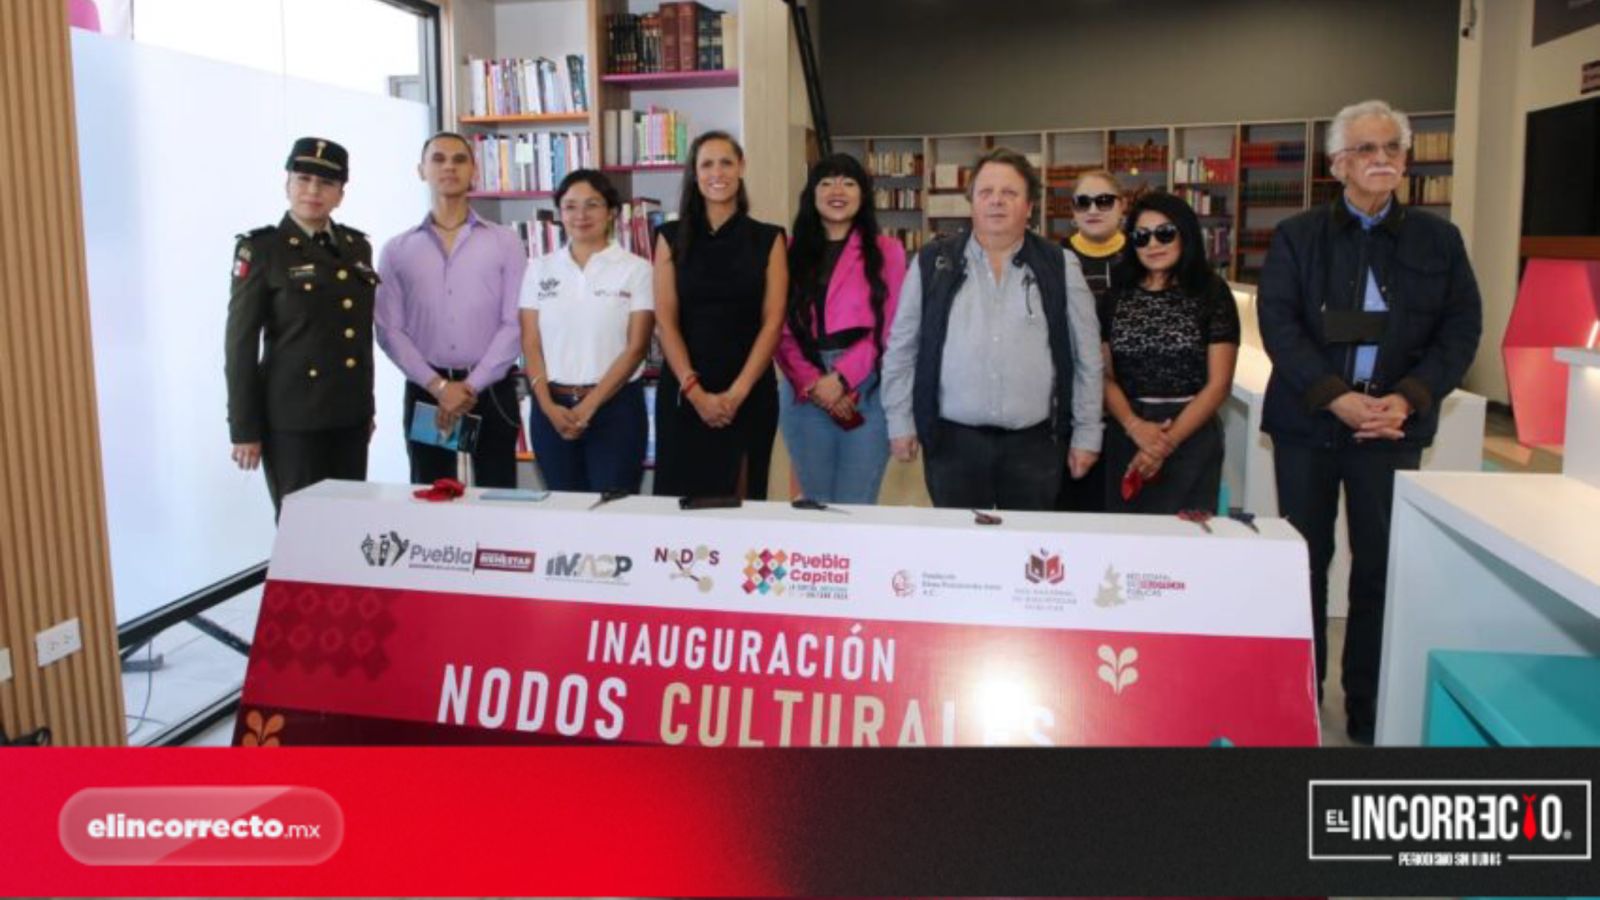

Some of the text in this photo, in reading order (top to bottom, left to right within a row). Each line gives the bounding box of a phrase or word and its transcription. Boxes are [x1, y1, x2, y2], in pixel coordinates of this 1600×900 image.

[789, 569, 849, 585] Capital
[587, 620, 896, 683] INAUGURACIÓN
[436, 663, 1056, 747] NODOS CULTURALS
